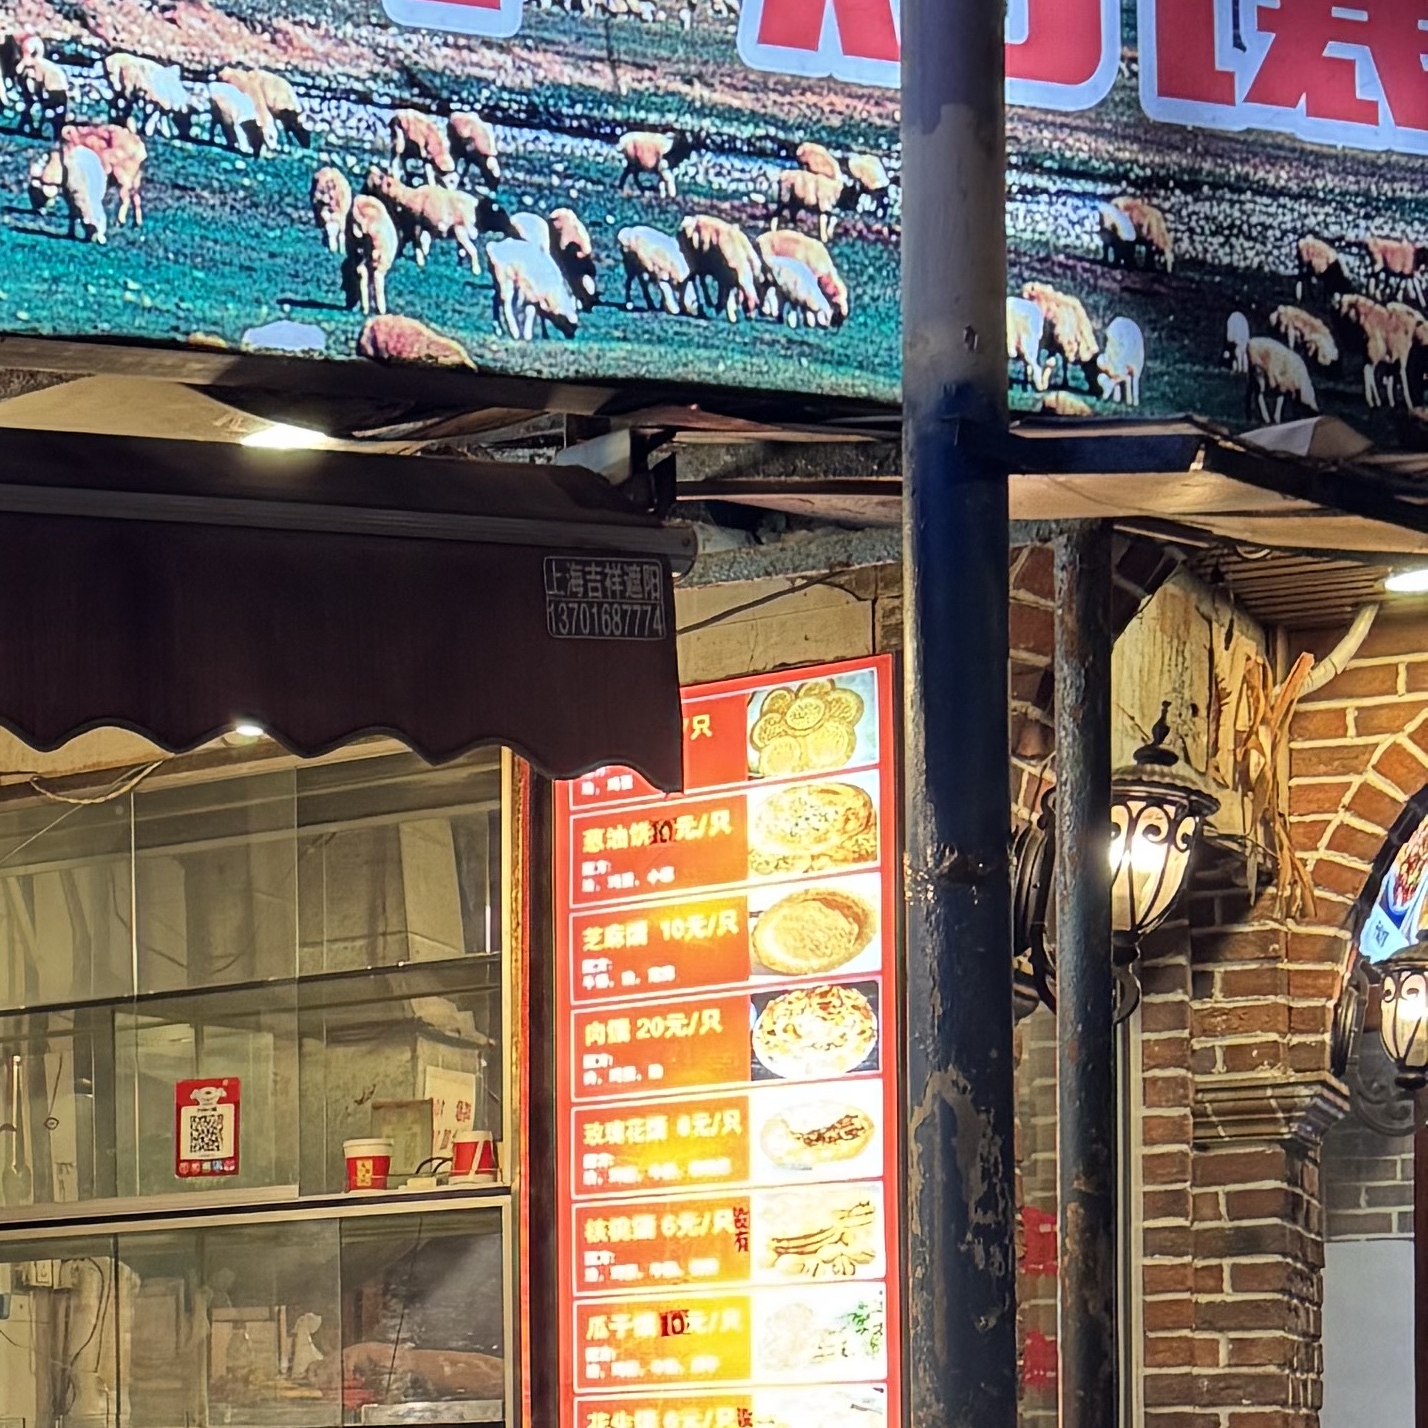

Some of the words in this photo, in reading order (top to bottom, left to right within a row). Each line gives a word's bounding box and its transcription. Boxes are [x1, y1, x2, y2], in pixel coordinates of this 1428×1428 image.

[548, 560, 660, 600] 上海吉祥遮阳
[548, 603, 663, 637] 13701687774
[659, 909, 740, 943] 10元/只
[635, 1008, 723, 1040] 20元/只
